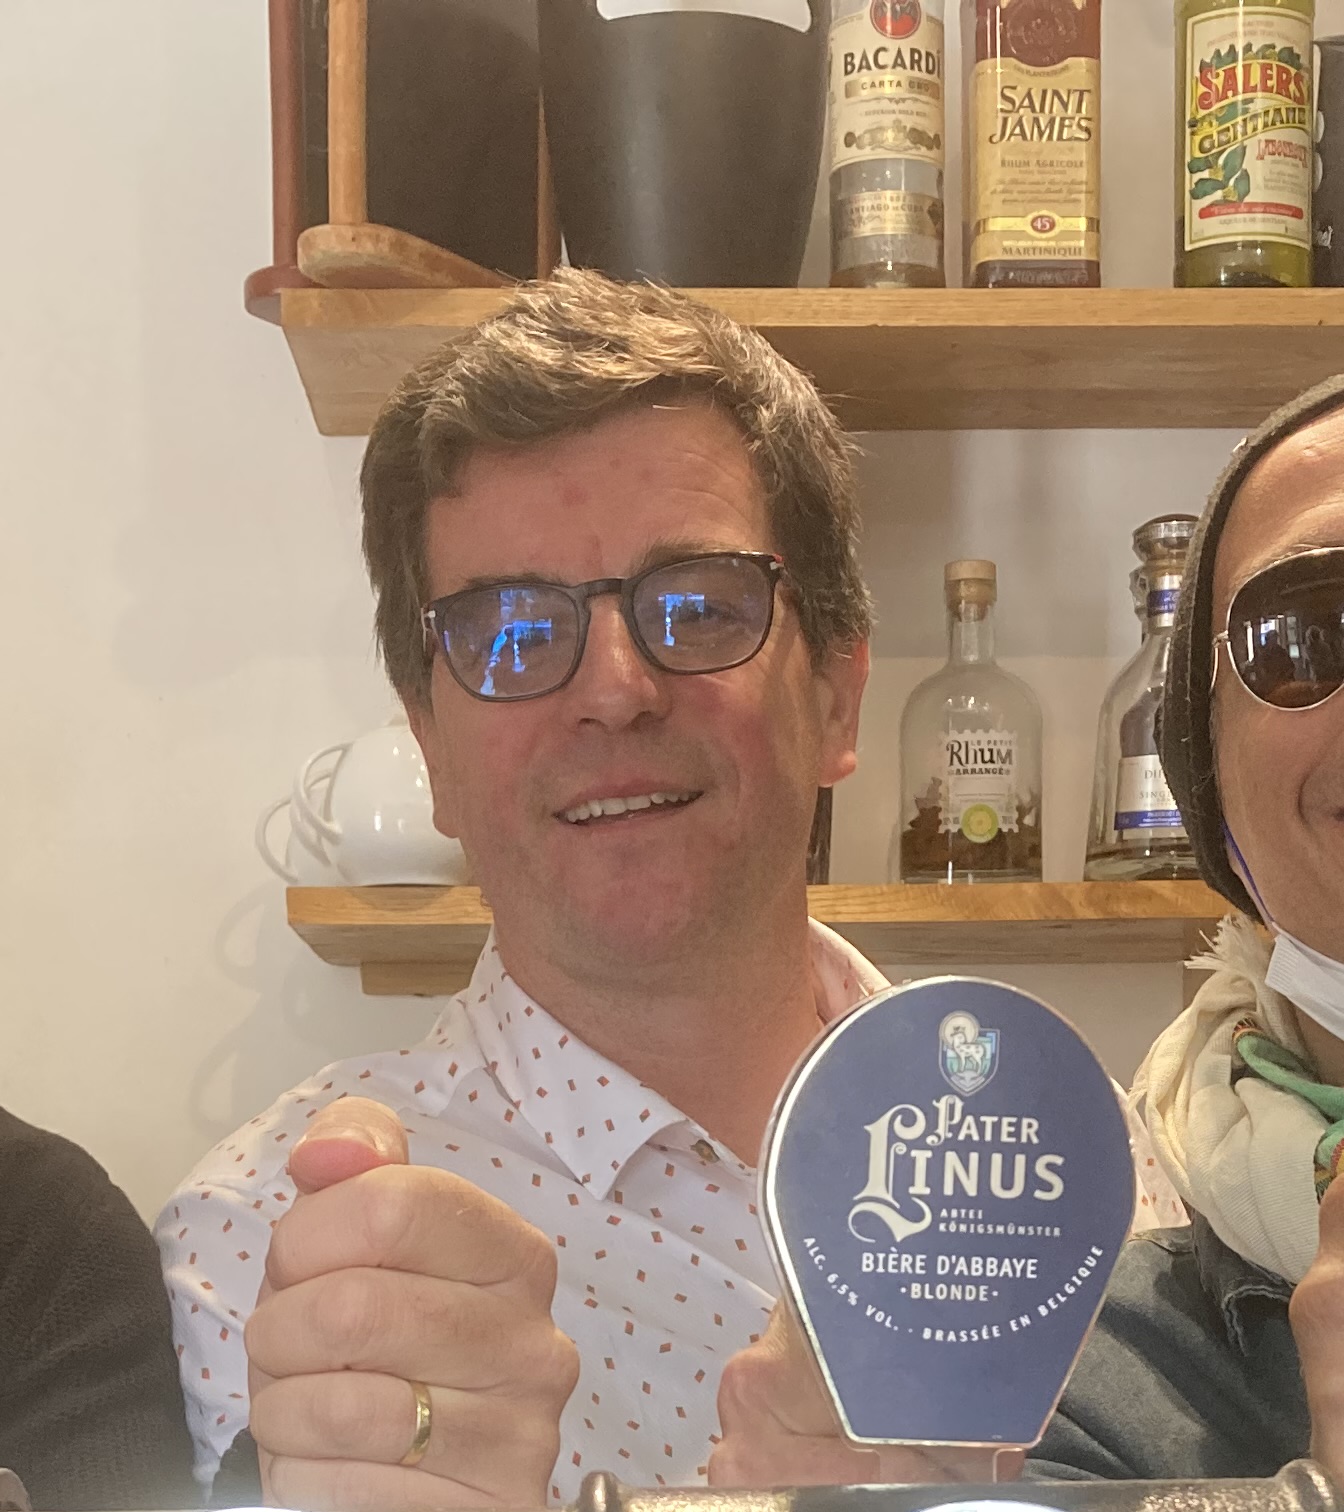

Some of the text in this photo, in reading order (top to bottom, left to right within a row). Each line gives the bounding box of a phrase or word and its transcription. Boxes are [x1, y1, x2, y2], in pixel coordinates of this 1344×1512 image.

[860, 79, 903, 91] CARTA
[999, 85, 1092, 114] SAINT
[1197, 62, 1306, 111] SALERS
[988, 115, 1093, 145] JAMES
[1198, 106, 1306, 154] GENTIANE
[926, 1094, 1040, 1146] PATER
[848, 1103, 1066, 1243] LINUS
[939, 1221, 1061, 1237] KÖNIGSMÜNSTER
[940, 1208, 983, 1219] ABTEI
[861, 1246, 1039, 1279] BIÈRE D'ABBAYE
[803, 1237, 827, 1271] ALC.
[865, 1304, 899, 1331] VOL.
[922, 1324, 1001, 1342] BRASSÉE
[1009, 1314, 1031, 1332] EN
[1037, 1245, 1104, 1317] BELGIQUE
